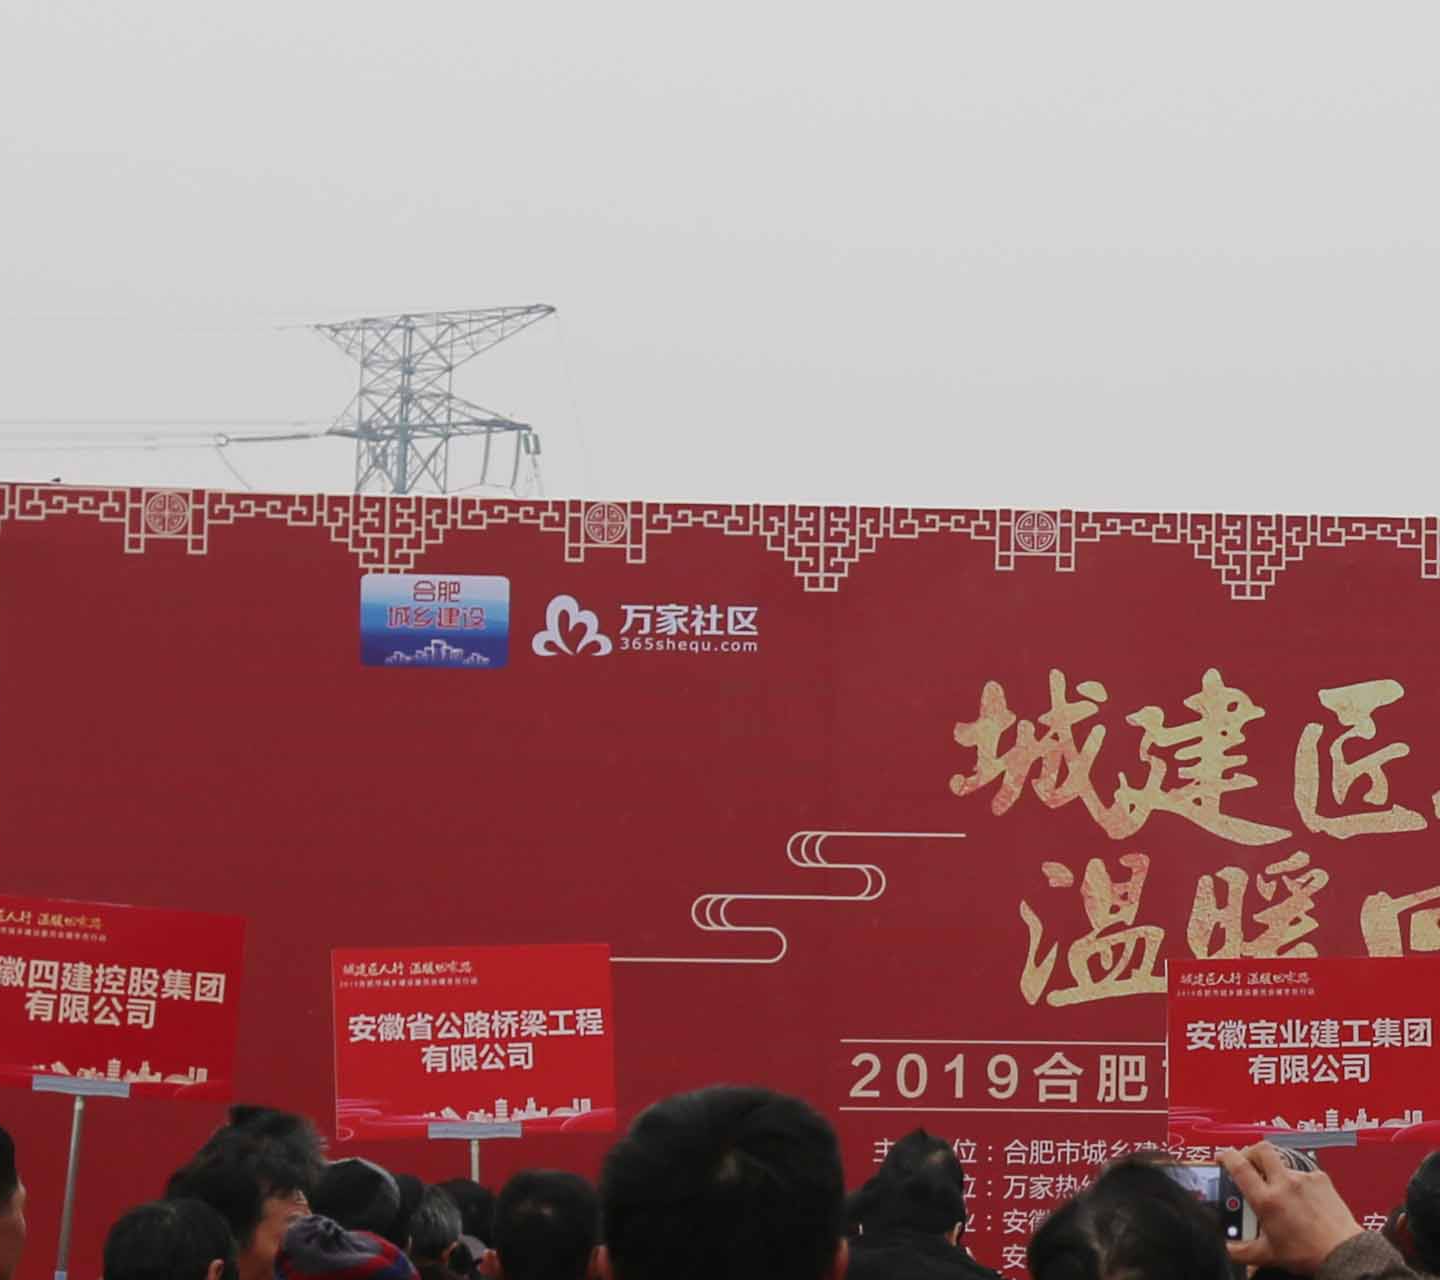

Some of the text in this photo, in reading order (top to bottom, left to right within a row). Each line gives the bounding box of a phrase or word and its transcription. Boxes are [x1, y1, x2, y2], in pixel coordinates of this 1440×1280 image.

[412, 580, 461, 603] 合肥
[386, 606, 486, 631] 城乡建设
[620, 604, 759, 636] 万家社区
[620, 637, 759, 654] 365shequ.com
[24, 990, 157, 1029] 有限公司
[348, 1007, 605, 1043] 安徽省公路桥梁工程
[1185, 1017, 1433, 1051] 安徽宝业建工集团
[421, 1042, 534, 1073] 有限公司
[1248, 1053, 1372, 1085] 有限公司
